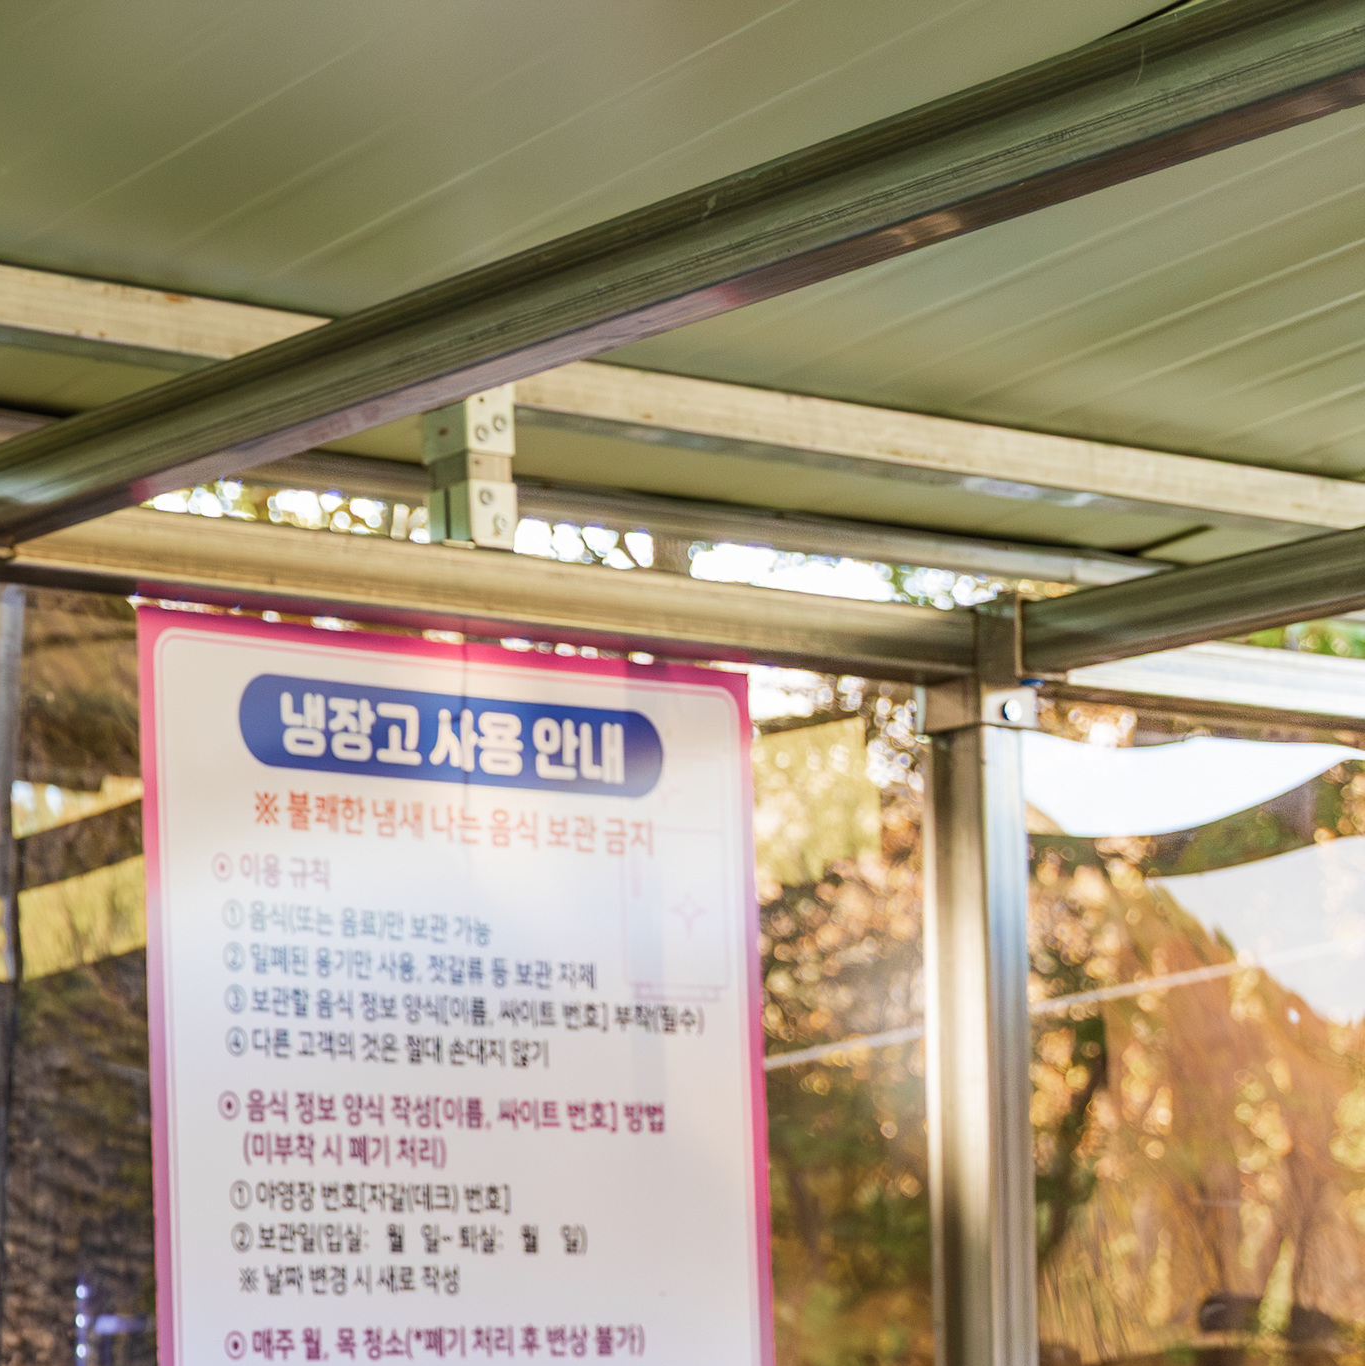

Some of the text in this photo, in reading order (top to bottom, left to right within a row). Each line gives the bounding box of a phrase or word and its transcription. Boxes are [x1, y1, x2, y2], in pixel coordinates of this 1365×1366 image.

[280, 691, 627, 785] 냉장고 사용 안내
[285, 790, 654, 857] 불쾌한 냄새 나는 음식 보관 금지
[242, 1133, 447, 1169] (미부착 시 폐기 처리)
